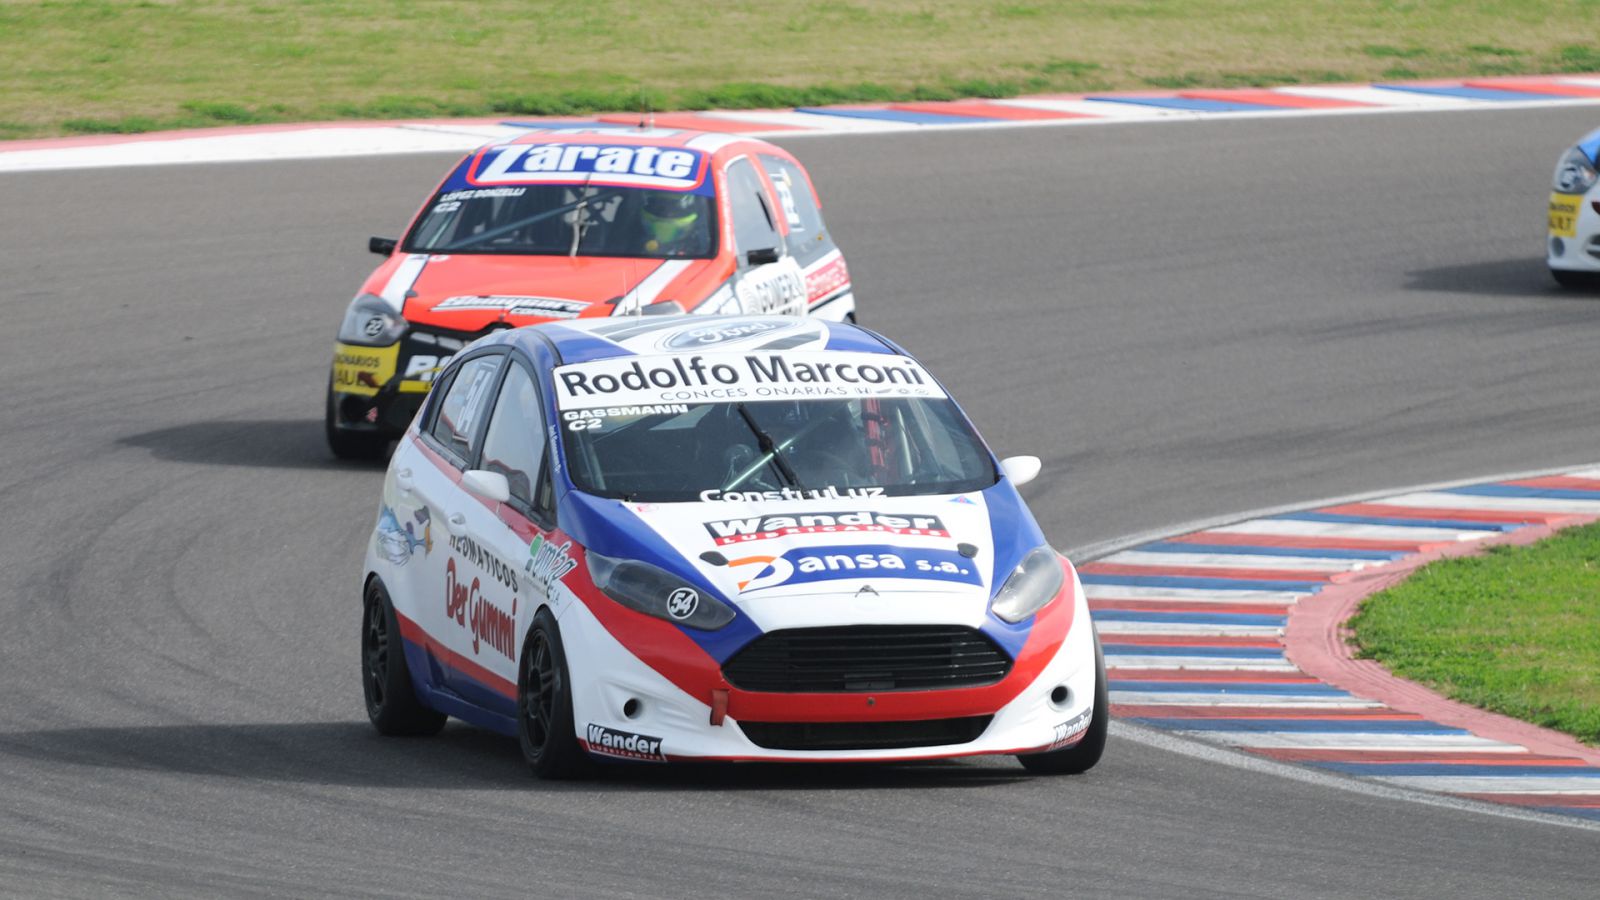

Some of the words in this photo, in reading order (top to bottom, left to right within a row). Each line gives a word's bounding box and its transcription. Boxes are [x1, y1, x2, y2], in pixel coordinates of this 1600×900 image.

[432, 201, 461, 213] C2
[365, 318, 382, 336] 22
[692, 320, 776, 343] Ford
[559, 356, 740, 397] Rodolfo
[744, 354, 925, 385] Marconi
[660, 387, 748, 401] CONCES
[563, 404, 689, 421] GASSMANN
[568, 418, 602, 431] C2
[699, 485, 887, 502] ConstruLuz
[710, 511, 936, 537] Wander
[723, 525, 943, 544] LUBRICANTES
[915, 559, 969, 575] s.a.
[446, 556, 468, 628] Der
[469, 576, 518, 663] Gummi
[670, 592, 695, 614] 54
[588, 725, 660, 754] Wander
